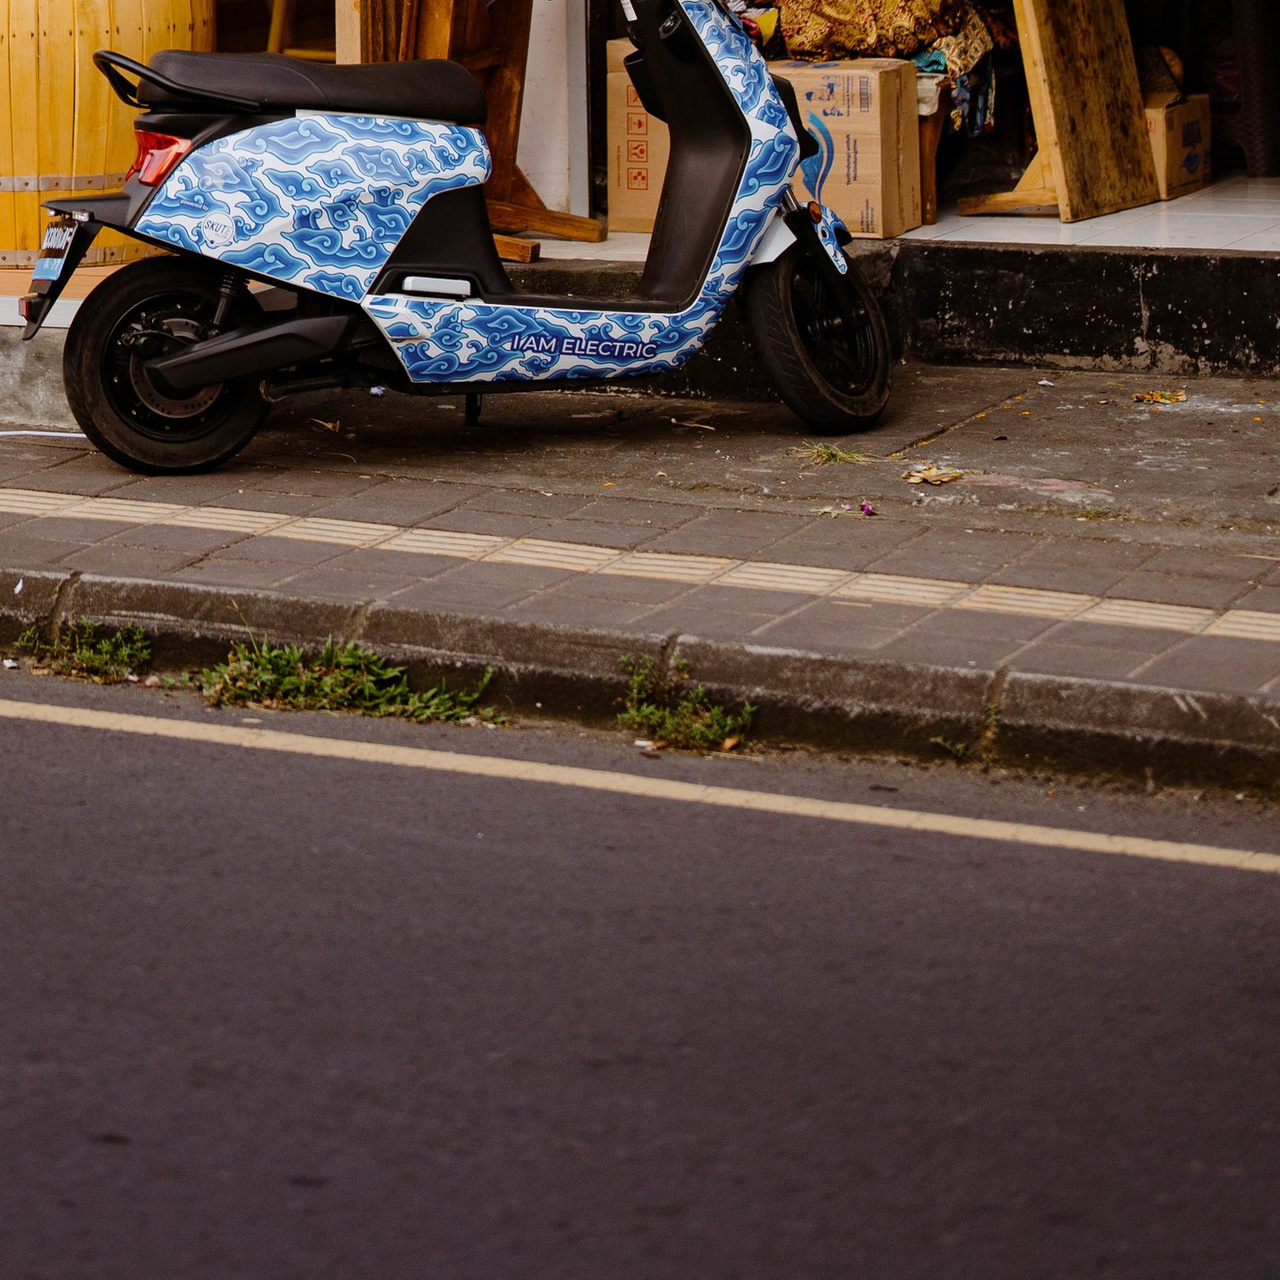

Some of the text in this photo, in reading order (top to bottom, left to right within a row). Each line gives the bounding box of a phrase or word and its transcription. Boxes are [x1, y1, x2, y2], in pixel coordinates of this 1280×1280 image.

[513, 335, 656, 358] I AM ELECTRIC
